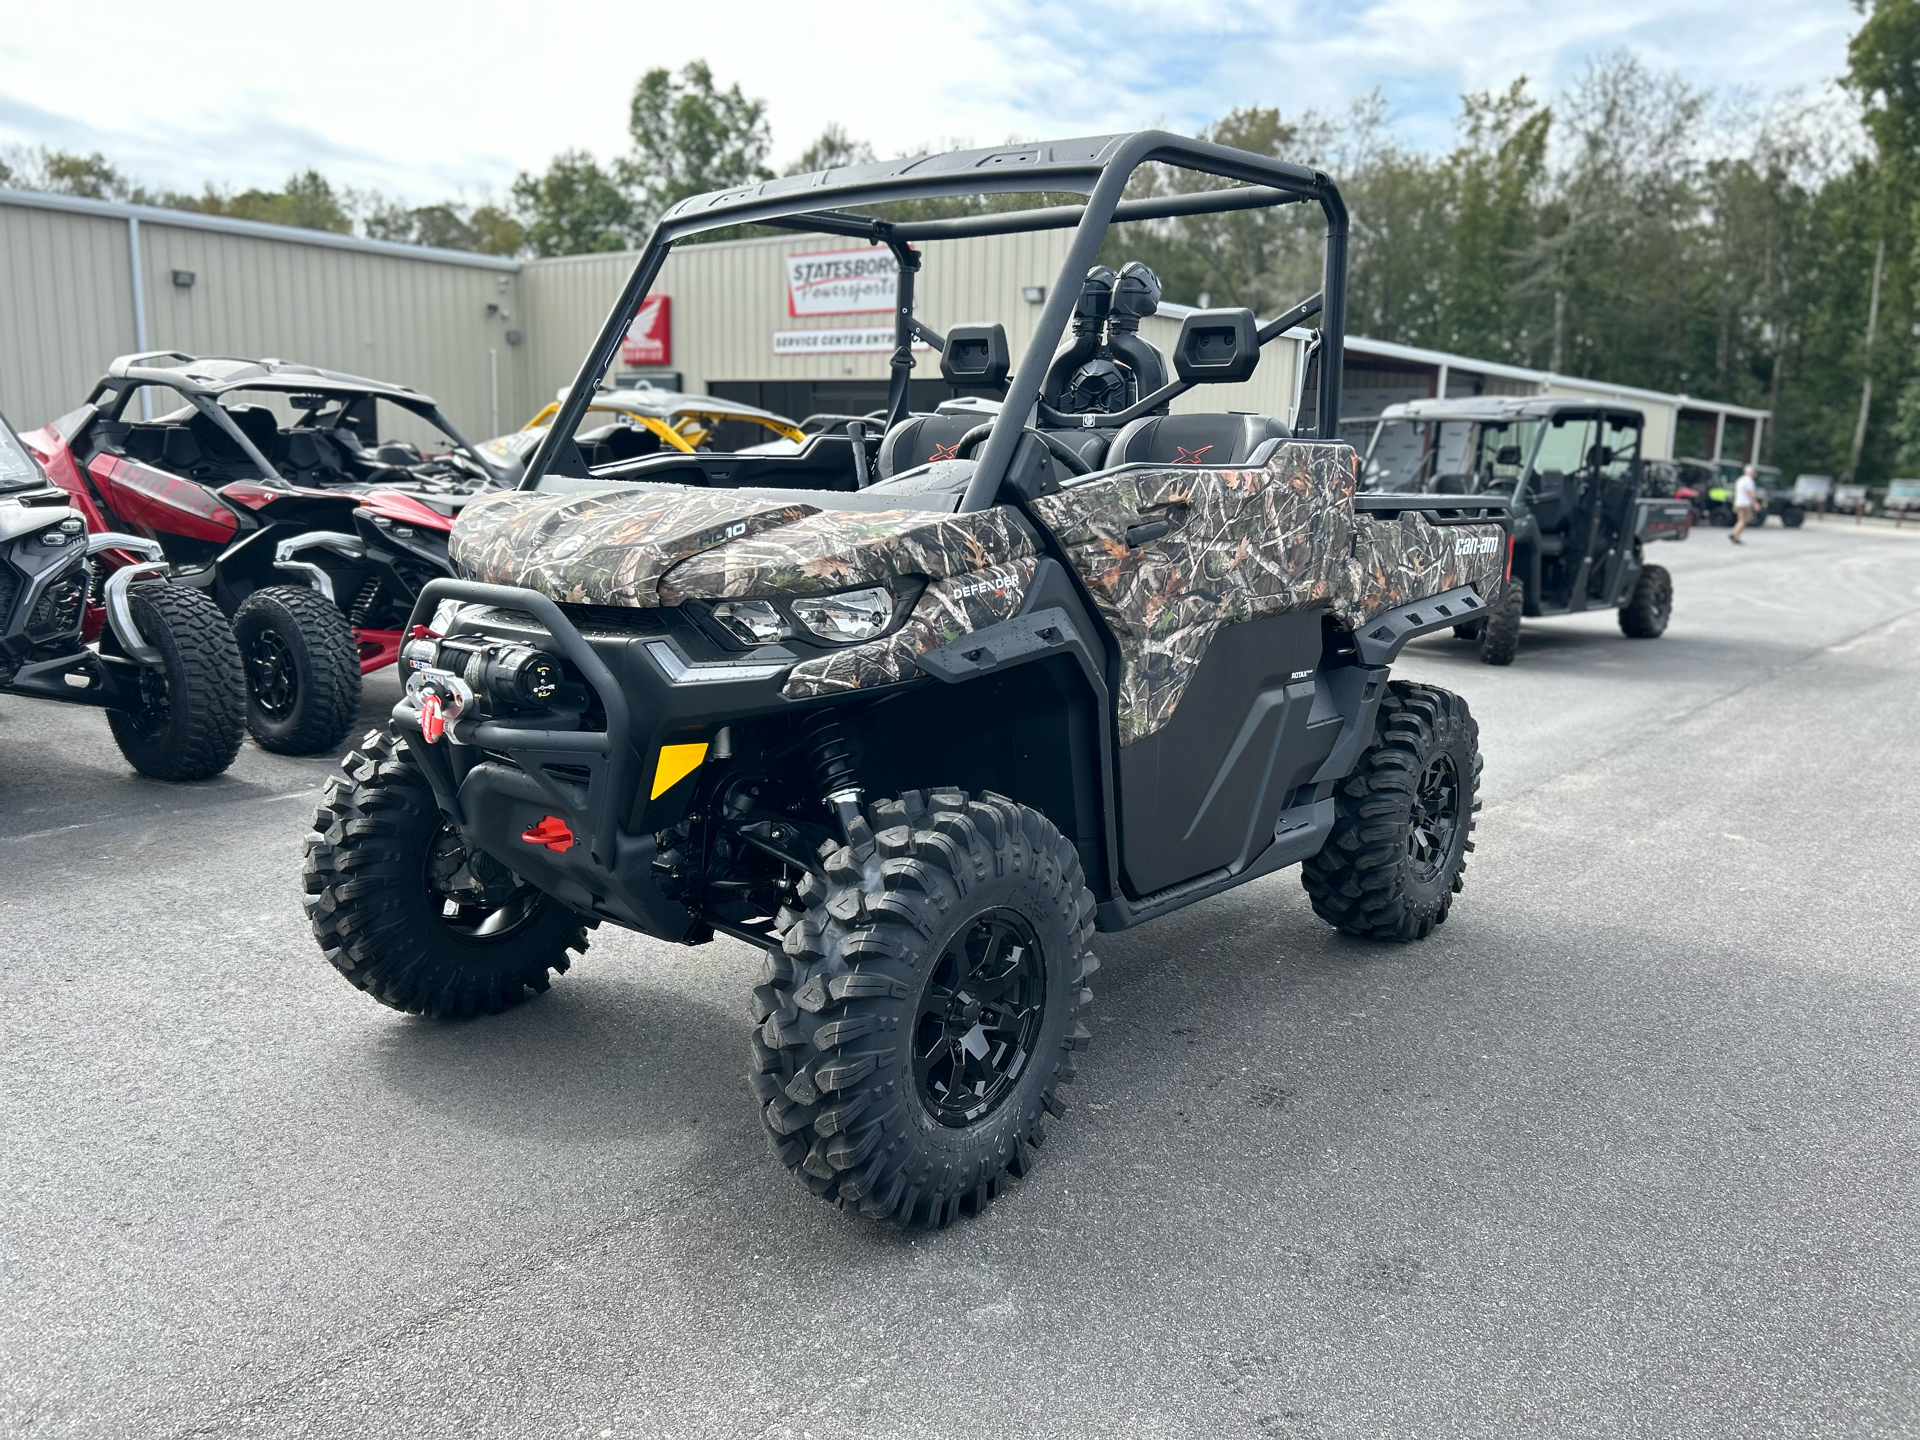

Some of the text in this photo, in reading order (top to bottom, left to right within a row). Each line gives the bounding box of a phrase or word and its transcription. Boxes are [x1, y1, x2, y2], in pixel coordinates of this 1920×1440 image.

[776, 336, 818, 347] SERVICE
[821, 334, 862, 346] CENTER
[699, 522, 746, 547] HD10
[1455, 536, 1498, 556] can-am
[953, 574, 1019, 599] DEFENDER
[1291, 670, 1307, 679] ROTAX
